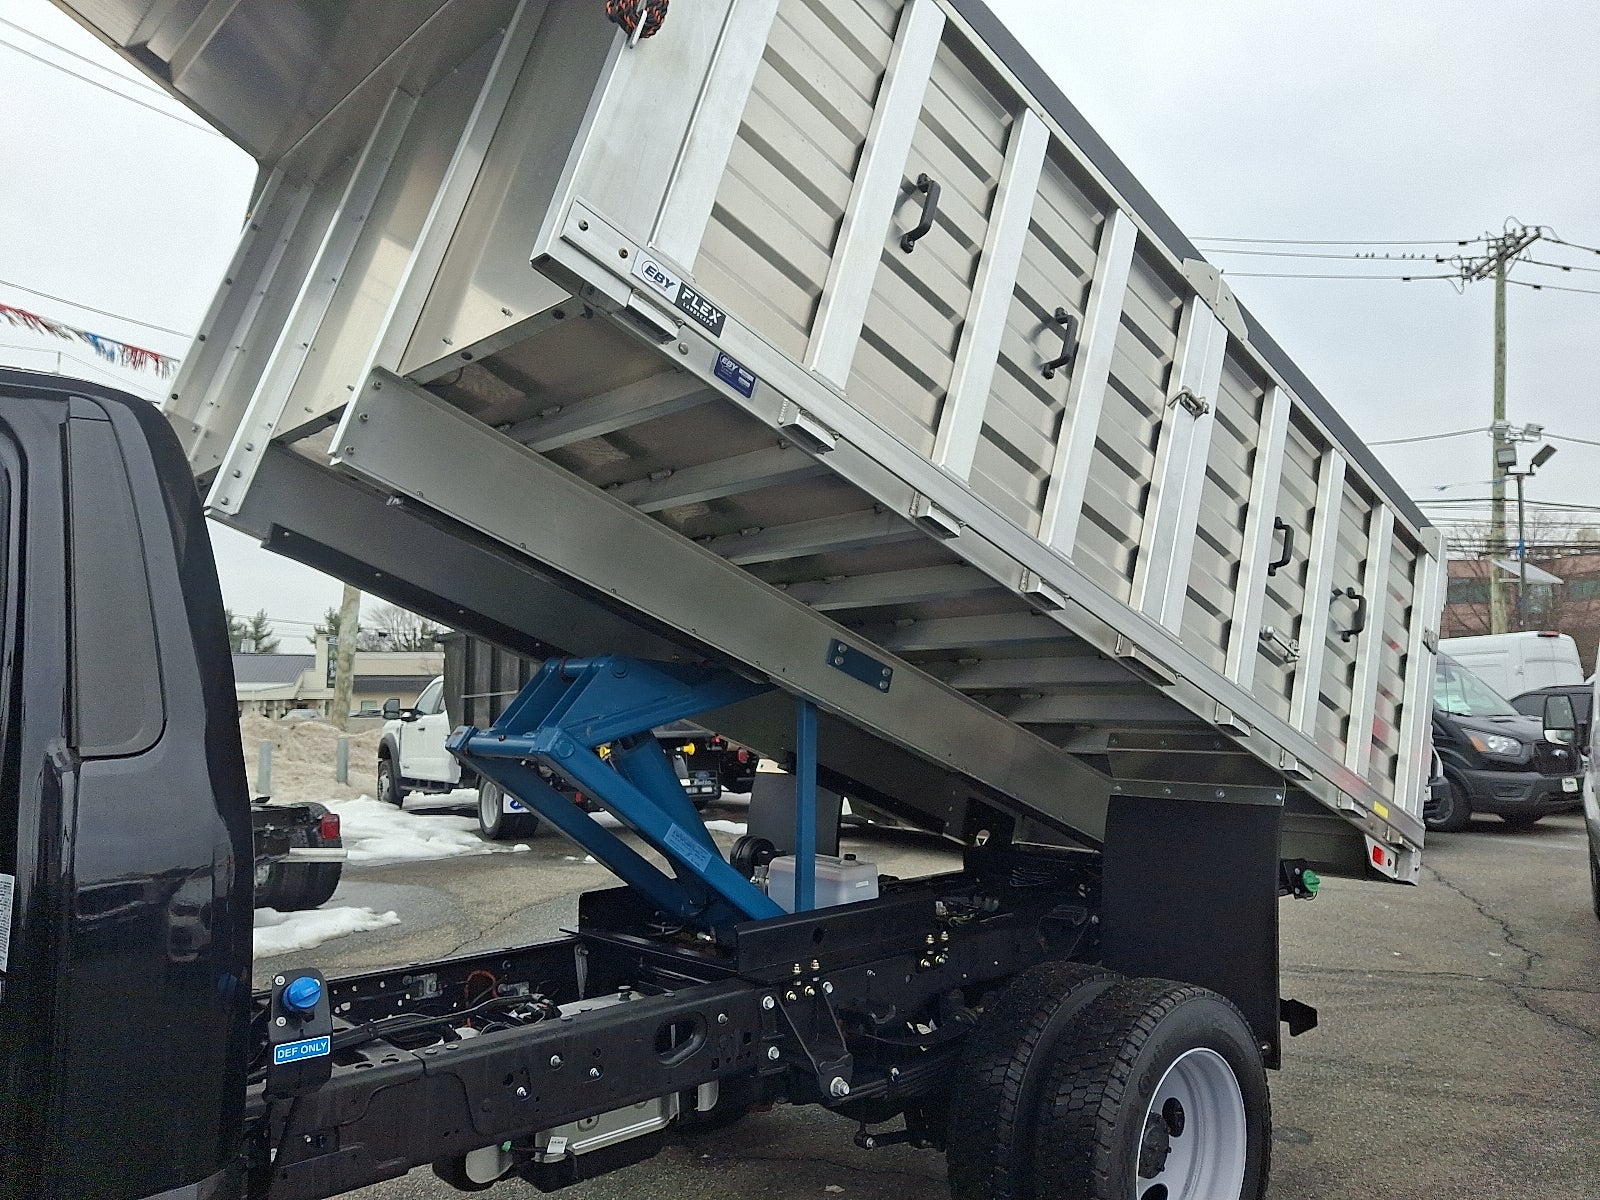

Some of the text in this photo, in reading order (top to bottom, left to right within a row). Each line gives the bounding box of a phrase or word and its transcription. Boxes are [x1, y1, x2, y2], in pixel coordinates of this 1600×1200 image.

[644, 265, 676, 289] EBY
[681, 288, 721, 324] FLEX
[722, 356, 738, 370] EBY
[278, 1041, 327, 1059] DEF ONLY
